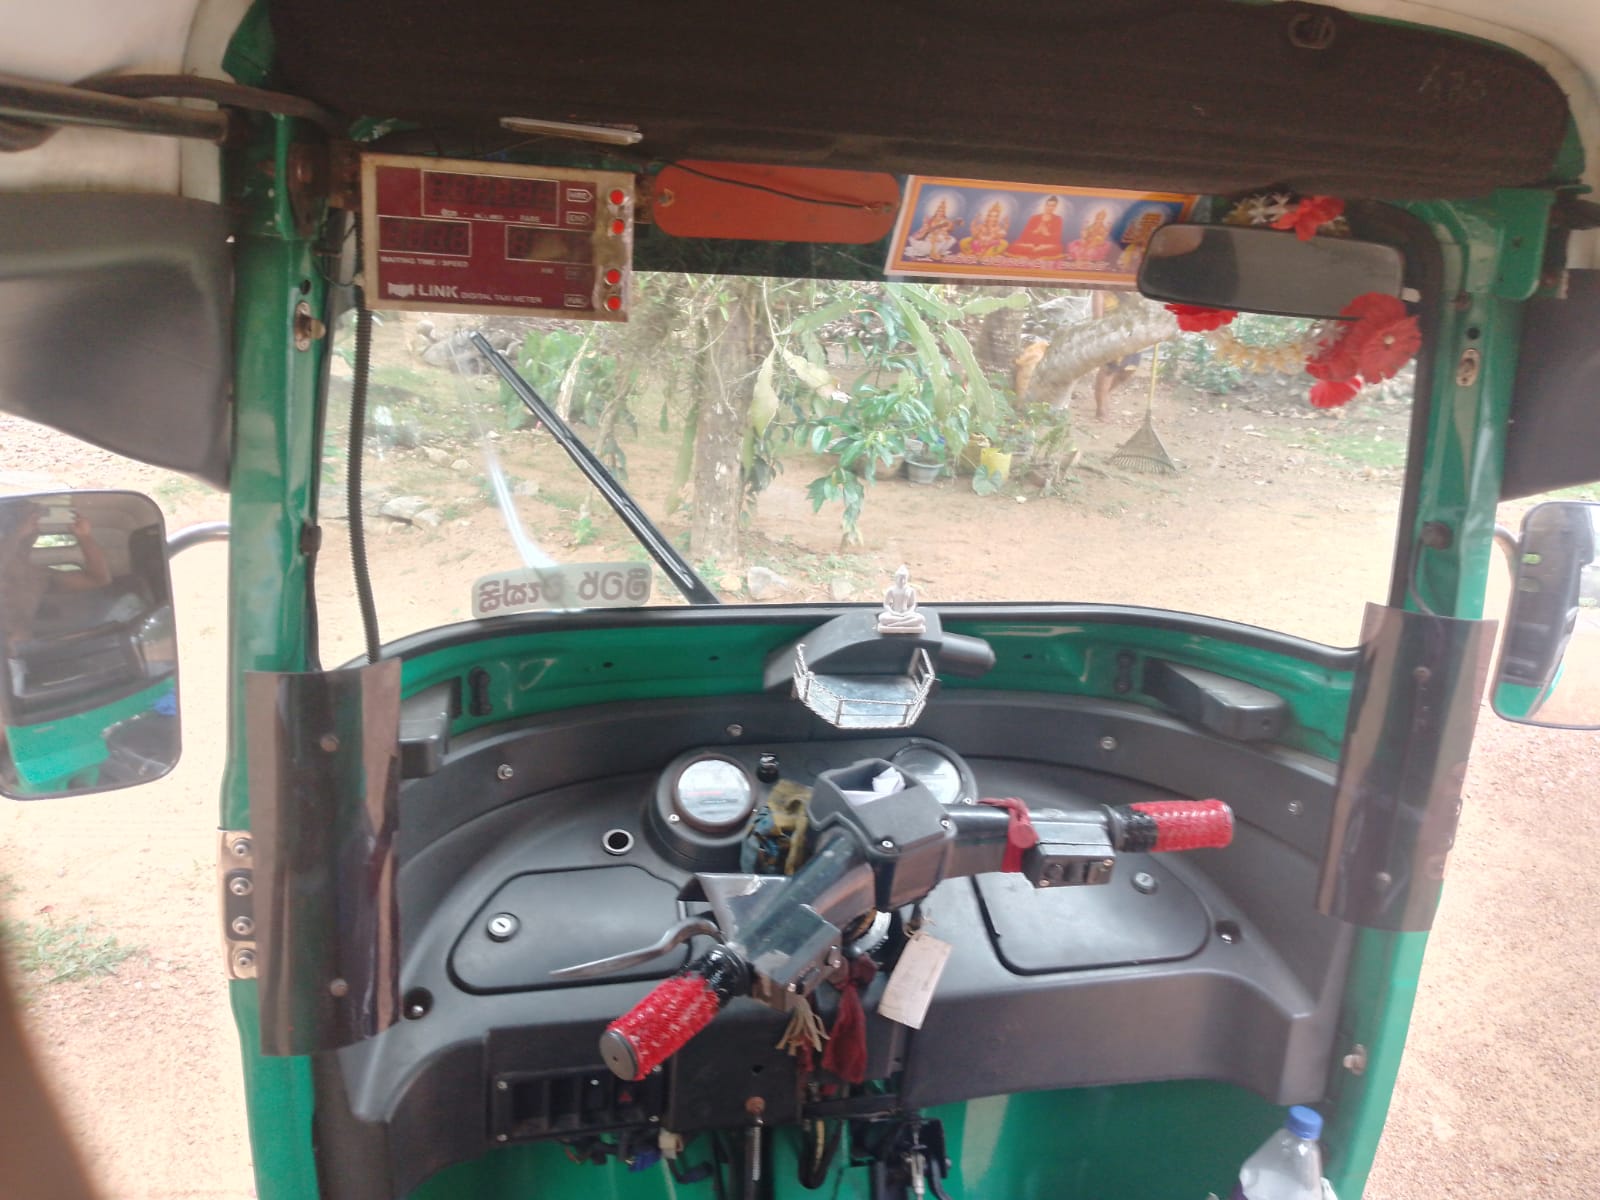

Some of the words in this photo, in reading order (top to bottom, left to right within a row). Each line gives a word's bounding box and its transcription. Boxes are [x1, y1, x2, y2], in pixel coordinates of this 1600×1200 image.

[381, 256, 417, 265] WAITING
[416, 257, 437, 267] TIME
[442, 260, 469, 269] SPEED
[418, 284, 459, 299] LINK
